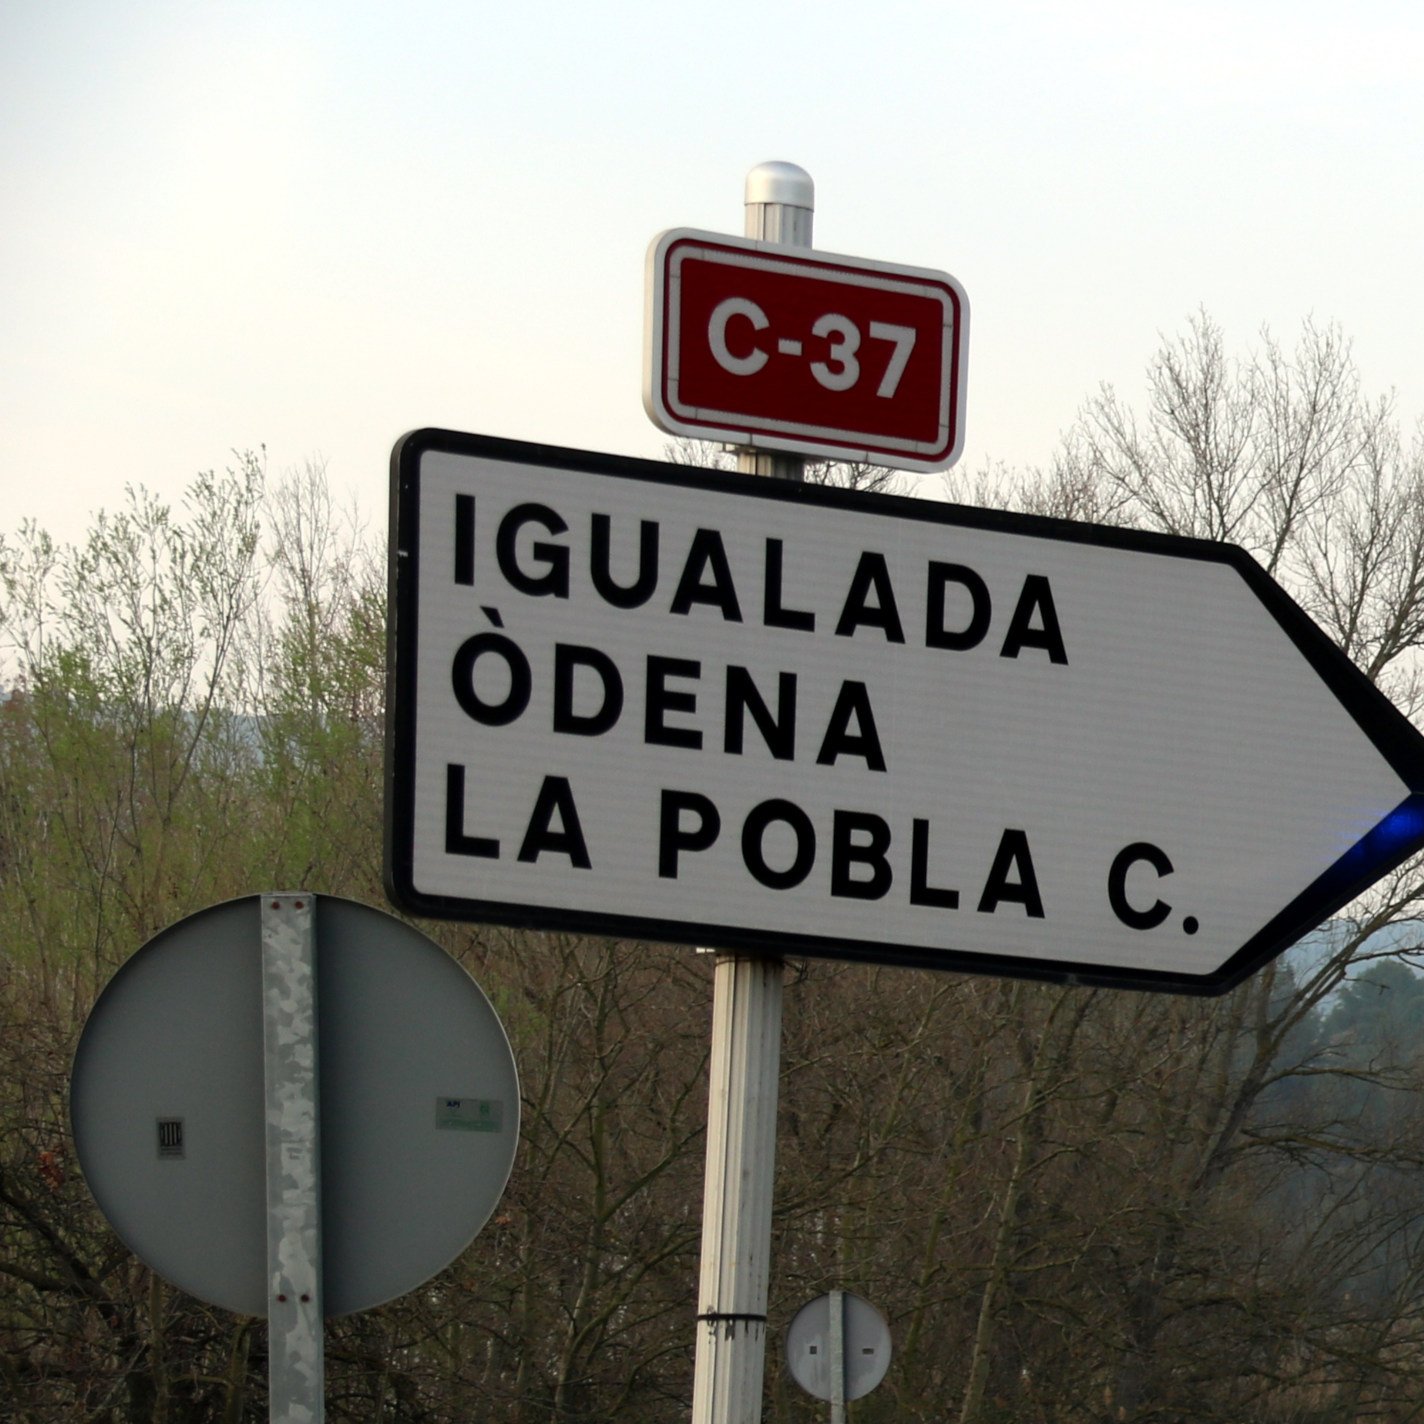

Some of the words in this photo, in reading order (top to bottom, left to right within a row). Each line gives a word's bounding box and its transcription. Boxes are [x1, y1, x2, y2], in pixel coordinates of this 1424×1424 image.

[708, 296, 916, 400] C-37
[453, 493, 1069, 667] IGUALADA
[450, 606, 888, 773] ÒDENA
[444, 763, 593, 871] LA
[657, 788, 1046, 919] POBLA
[1107, 840, 1200, 937] C.
